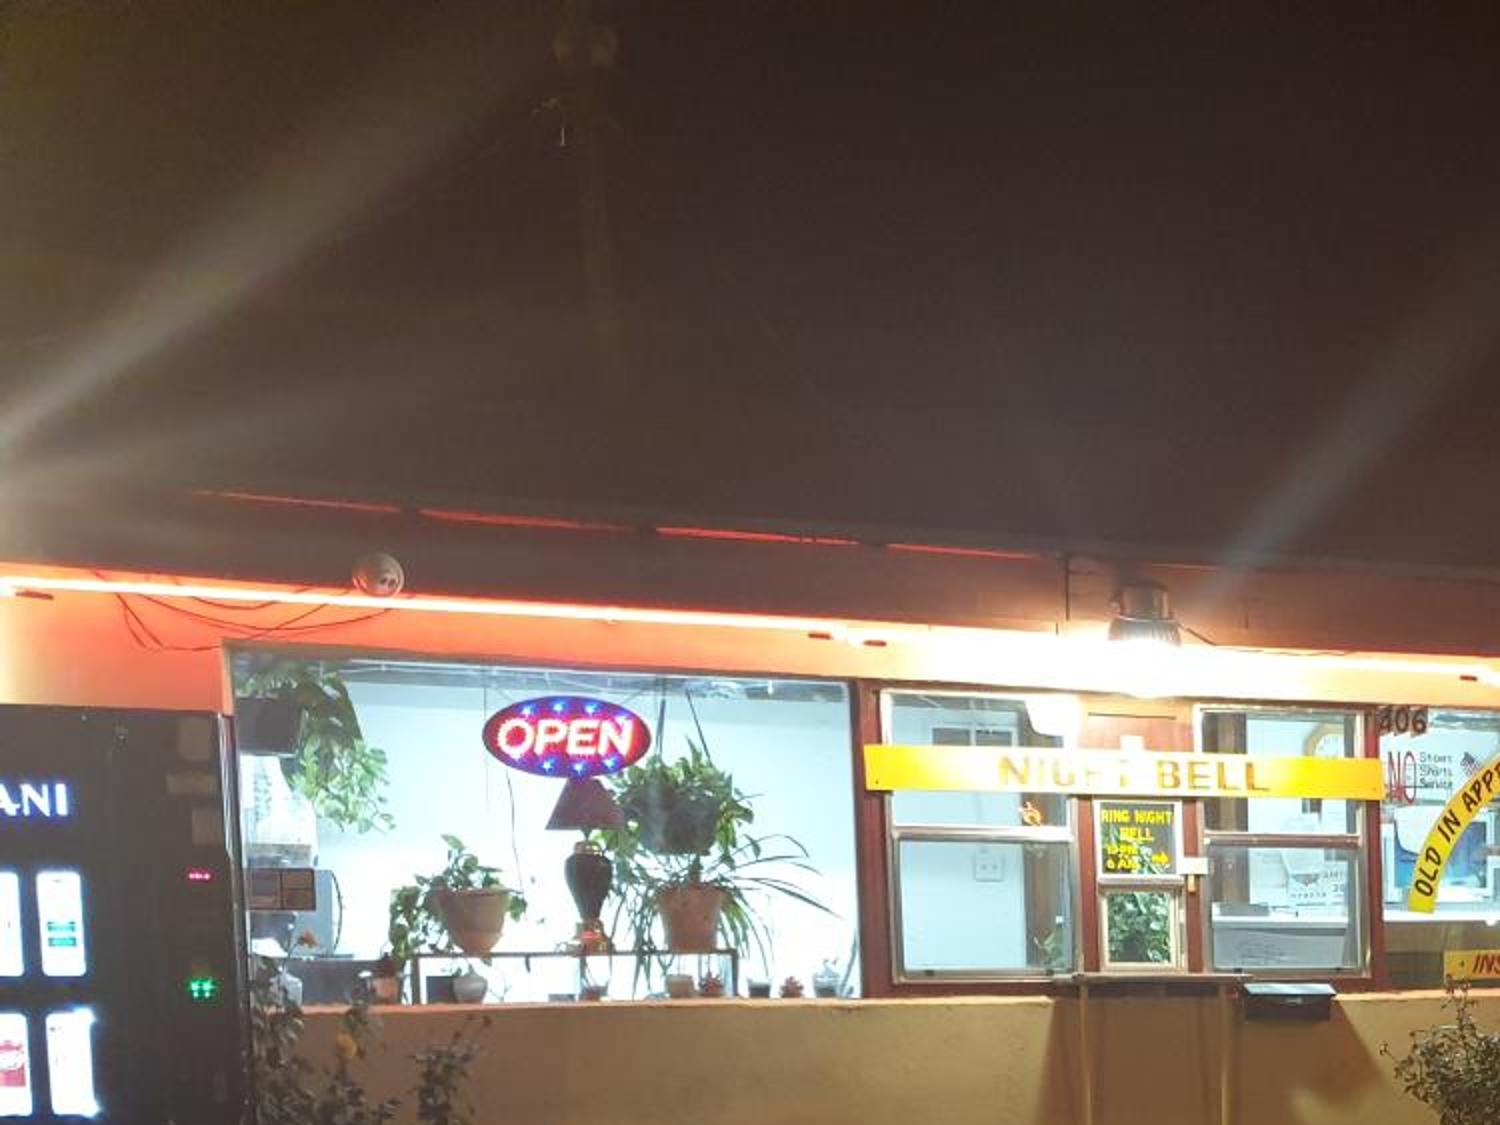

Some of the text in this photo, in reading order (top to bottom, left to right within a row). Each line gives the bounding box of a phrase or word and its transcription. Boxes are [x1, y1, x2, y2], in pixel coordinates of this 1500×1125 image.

[497, 718, 635, 757] OPEN
[997, 756, 1270, 792] NIG BELL
[1415, 847, 1441, 896] OLD
[1438, 809, 1461, 843] IN
